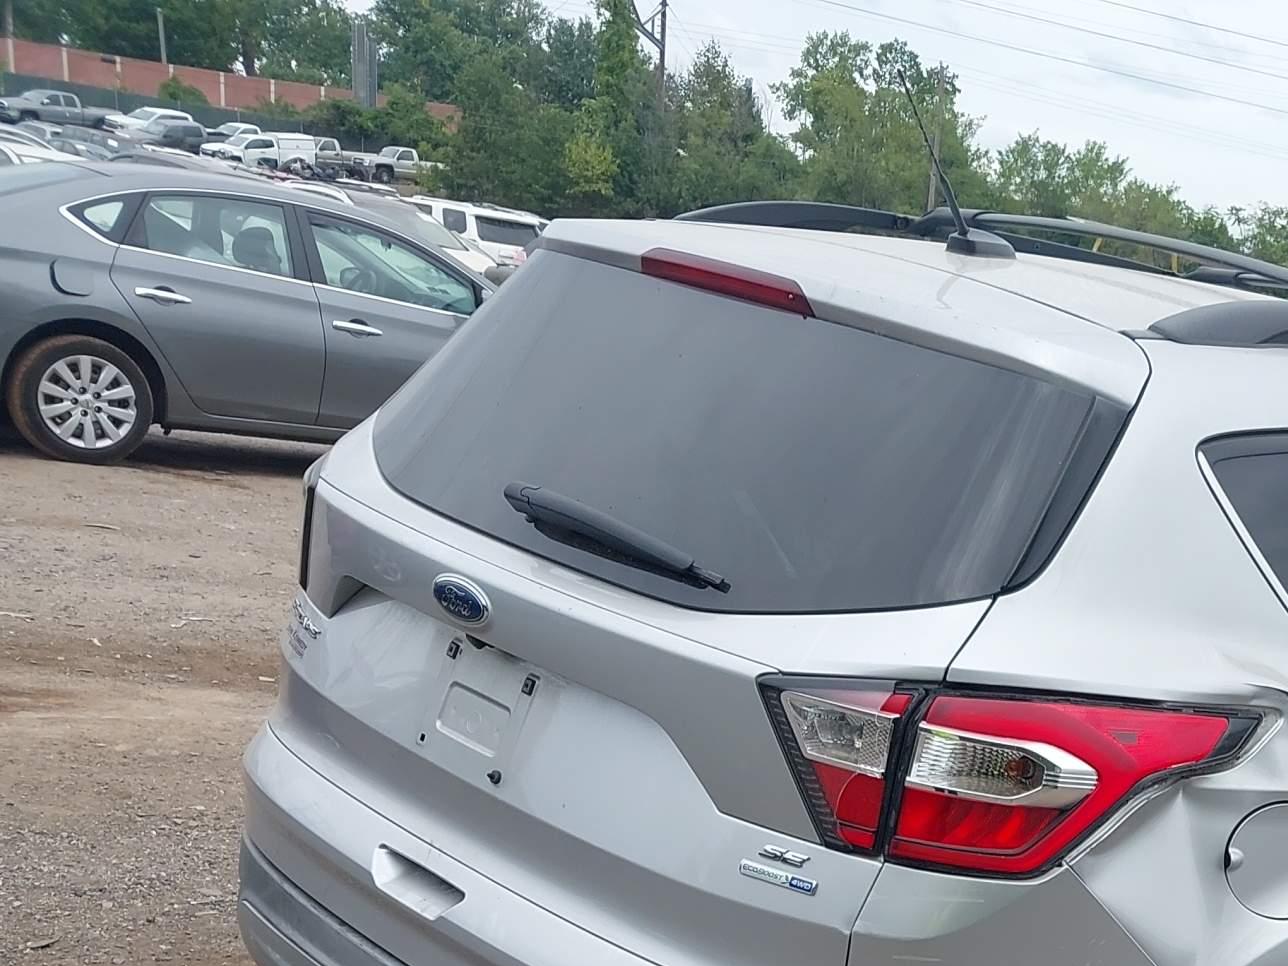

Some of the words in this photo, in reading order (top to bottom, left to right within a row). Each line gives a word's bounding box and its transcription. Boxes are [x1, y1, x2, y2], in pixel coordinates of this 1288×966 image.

[440, 584, 474, 617] Ford
[757, 844, 811, 868] SE
[790, 879, 813, 891] 4WD
